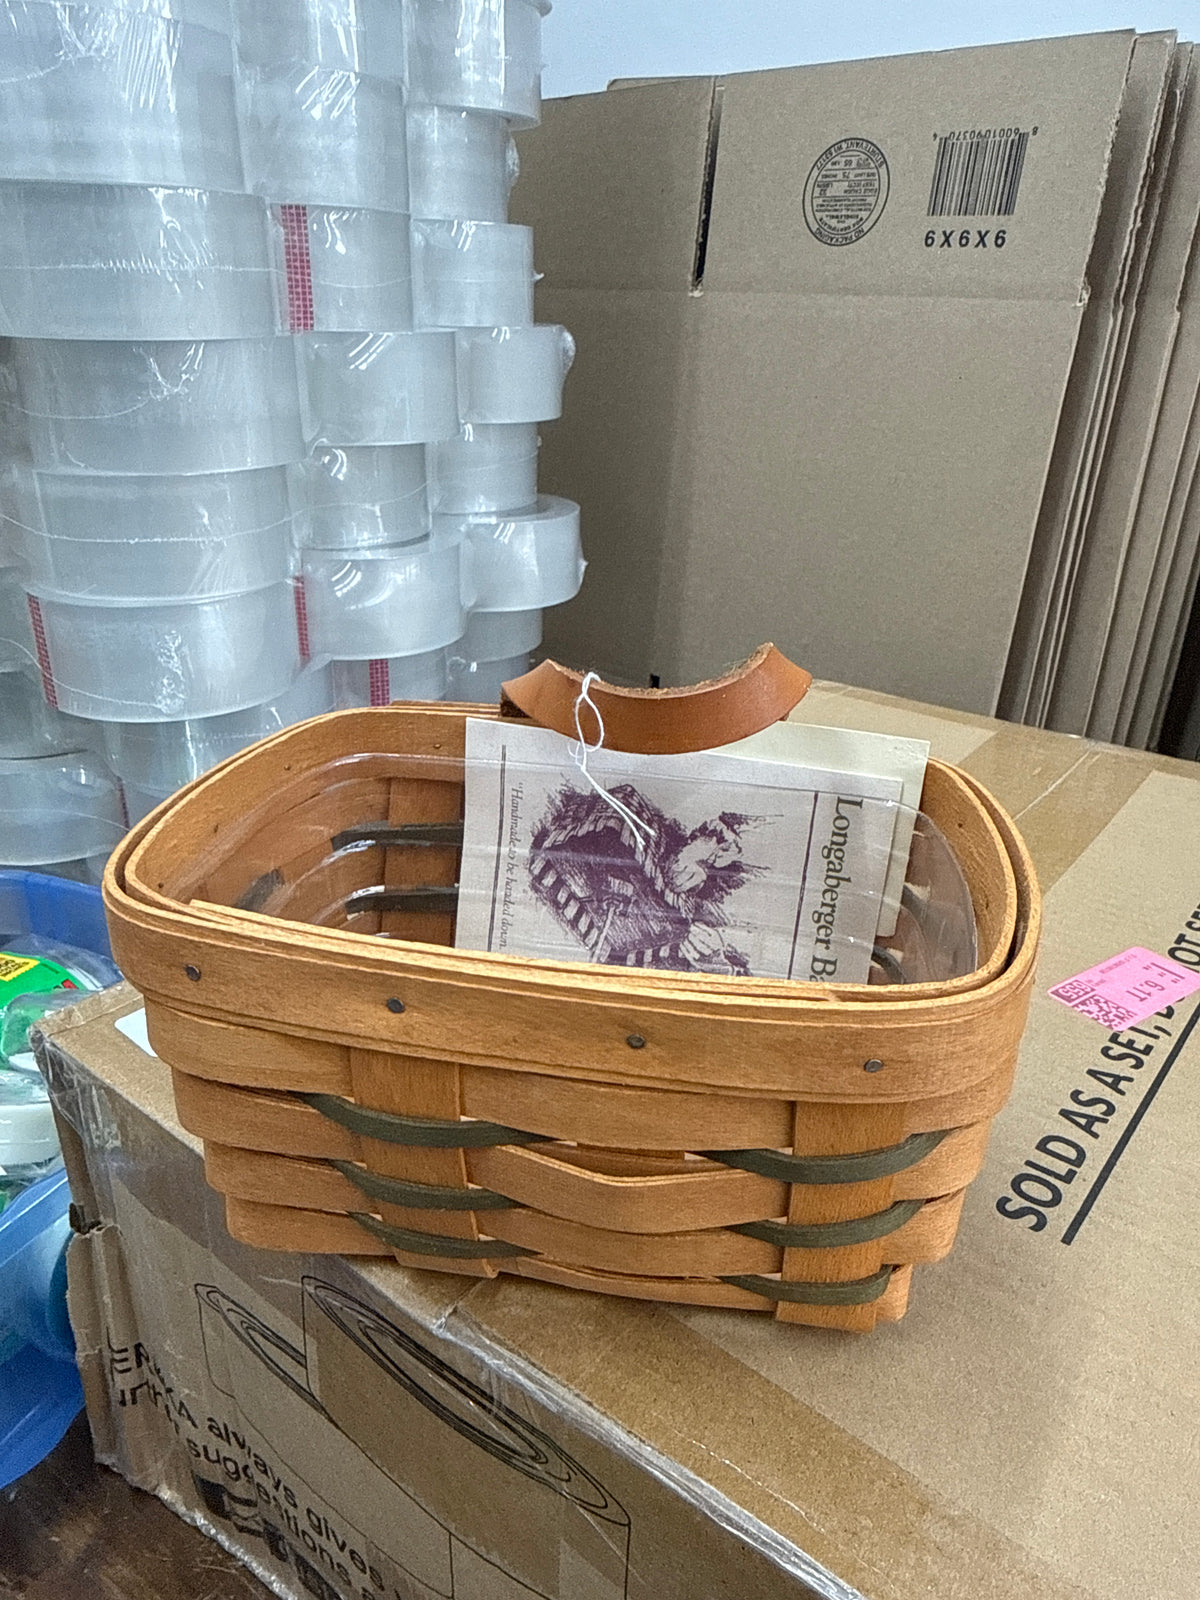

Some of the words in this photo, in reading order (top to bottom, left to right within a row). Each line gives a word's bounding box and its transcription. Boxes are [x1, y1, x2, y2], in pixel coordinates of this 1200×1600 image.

[811, 796, 864, 950] Longaberger
[1058, 1089, 1117, 1139] AS
[1086, 1067, 1135, 1096] A
[996, 1135, 1087, 1232] SOLD
[305, 1506, 384, 1592] gives
